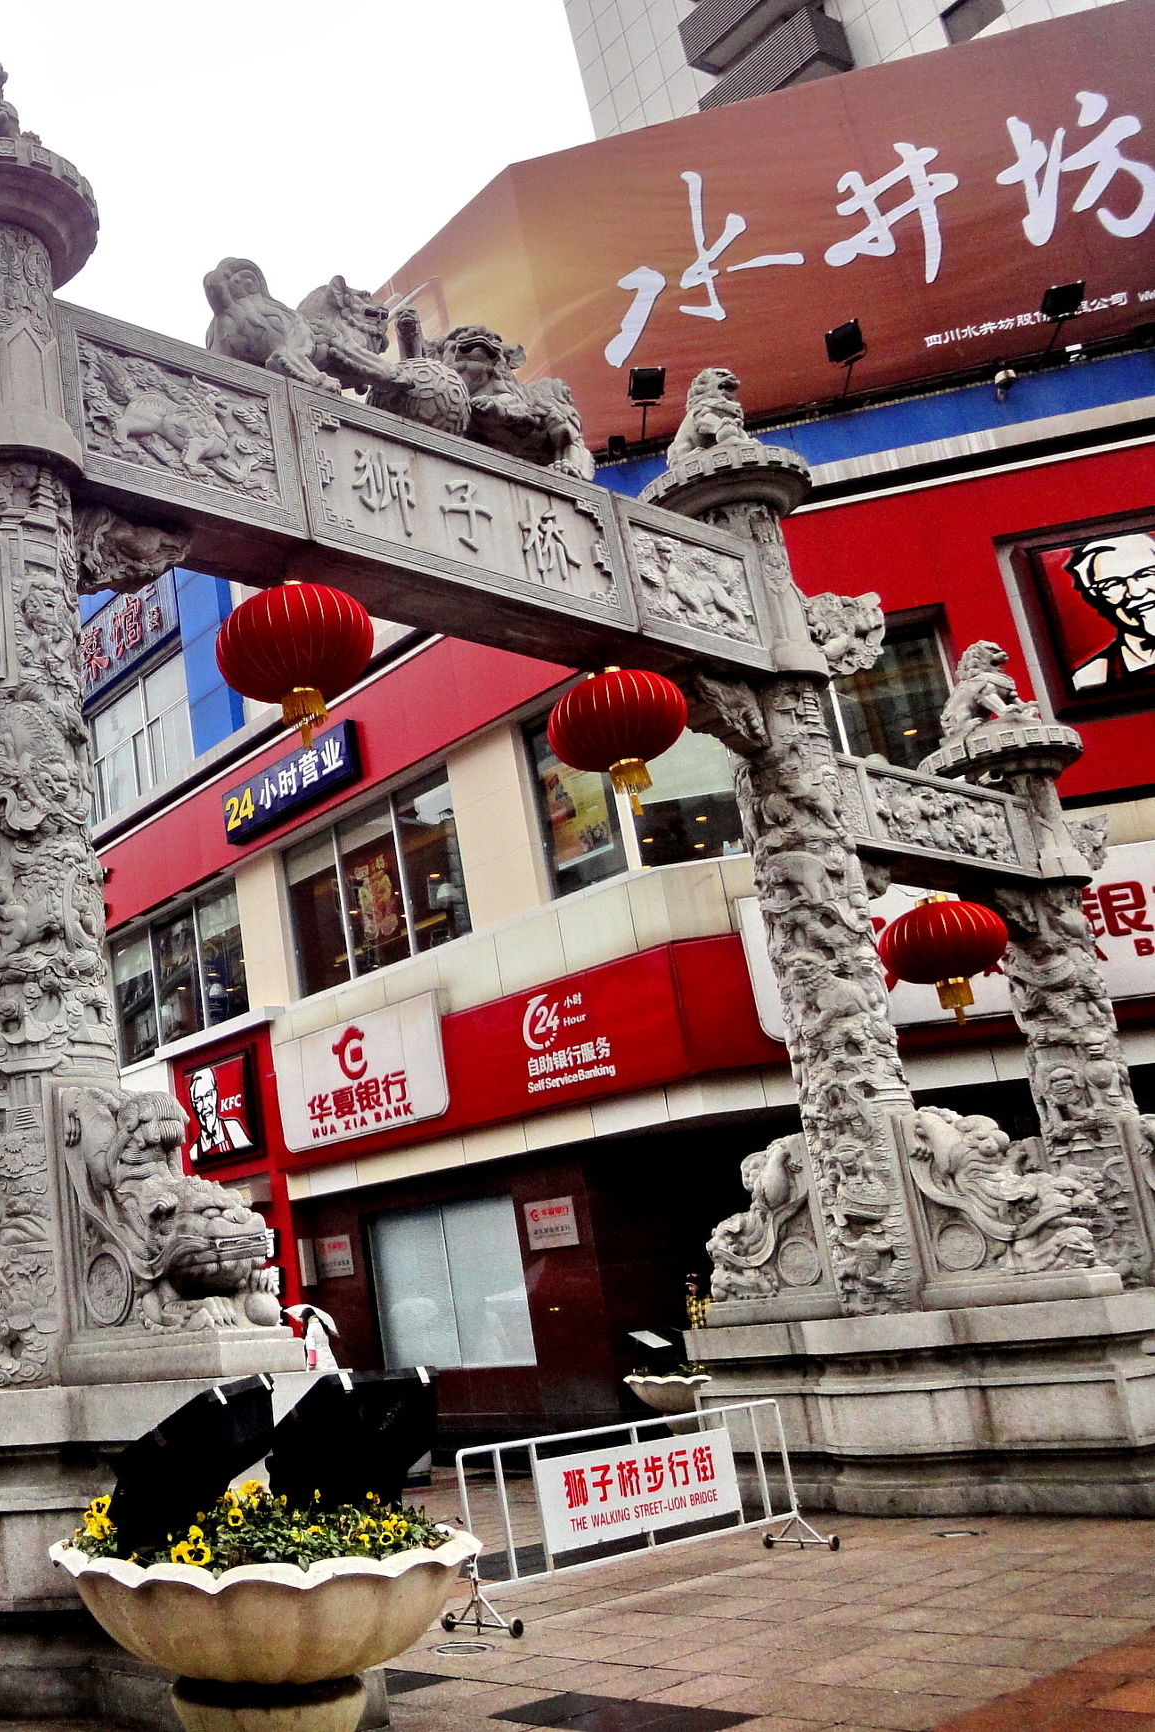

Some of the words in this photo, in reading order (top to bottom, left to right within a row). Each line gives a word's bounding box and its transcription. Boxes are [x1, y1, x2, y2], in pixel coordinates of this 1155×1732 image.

[604, 91, 1155, 369] 水井坊
[352, 449, 583, 581] 狮子桥
[534, 1002, 560, 1035] 24
[563, 991, 582, 1009] 小时
[563, 1013, 586, 1027] Hour
[527, 1036, 611, 1078] 自助银行服务
[220, 1093, 242, 1113] KFC
[307, 1069, 407, 1124] 华夏银行
[312, 1123, 337, 1139] HUA
[343, 1115, 368, 1131] XIA
[374, 1102, 414, 1123] BANK
[562, 1445, 716, 1510] 狮子桥步行街
[570, 1516, 588, 1533] THE
[590, 1507, 631, 1528] WALKING
[633, 1495, 687, 1519] STREET-LION
[690, 1488, 719, 1507] BRIDGE
